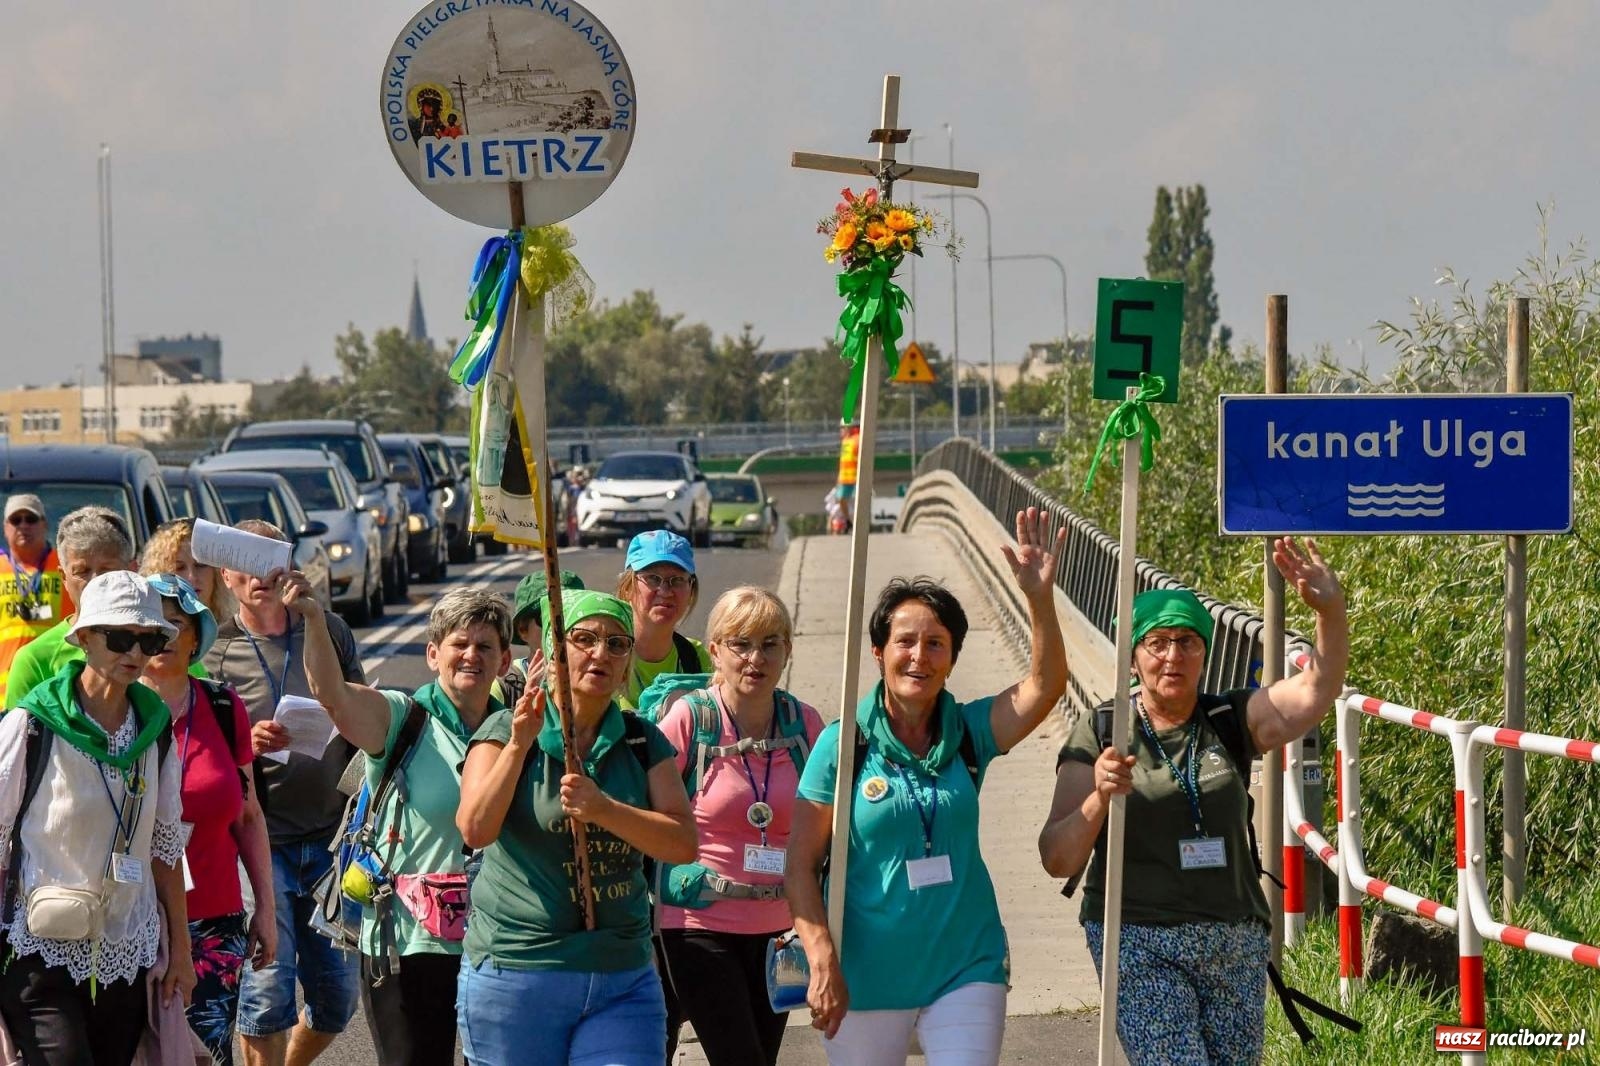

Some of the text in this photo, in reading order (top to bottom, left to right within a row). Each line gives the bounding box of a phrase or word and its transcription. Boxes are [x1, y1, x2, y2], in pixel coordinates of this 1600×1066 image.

[387, 55, 412, 141] OPOLSKA
[540, 0, 569, 22] NA
[572, 18, 620, 76] JASNA
[425, 136, 605, 179] KIETRZ
[1267, 419, 1526, 468] kanał Ulga
[607, 880, 633, 899] OFF
